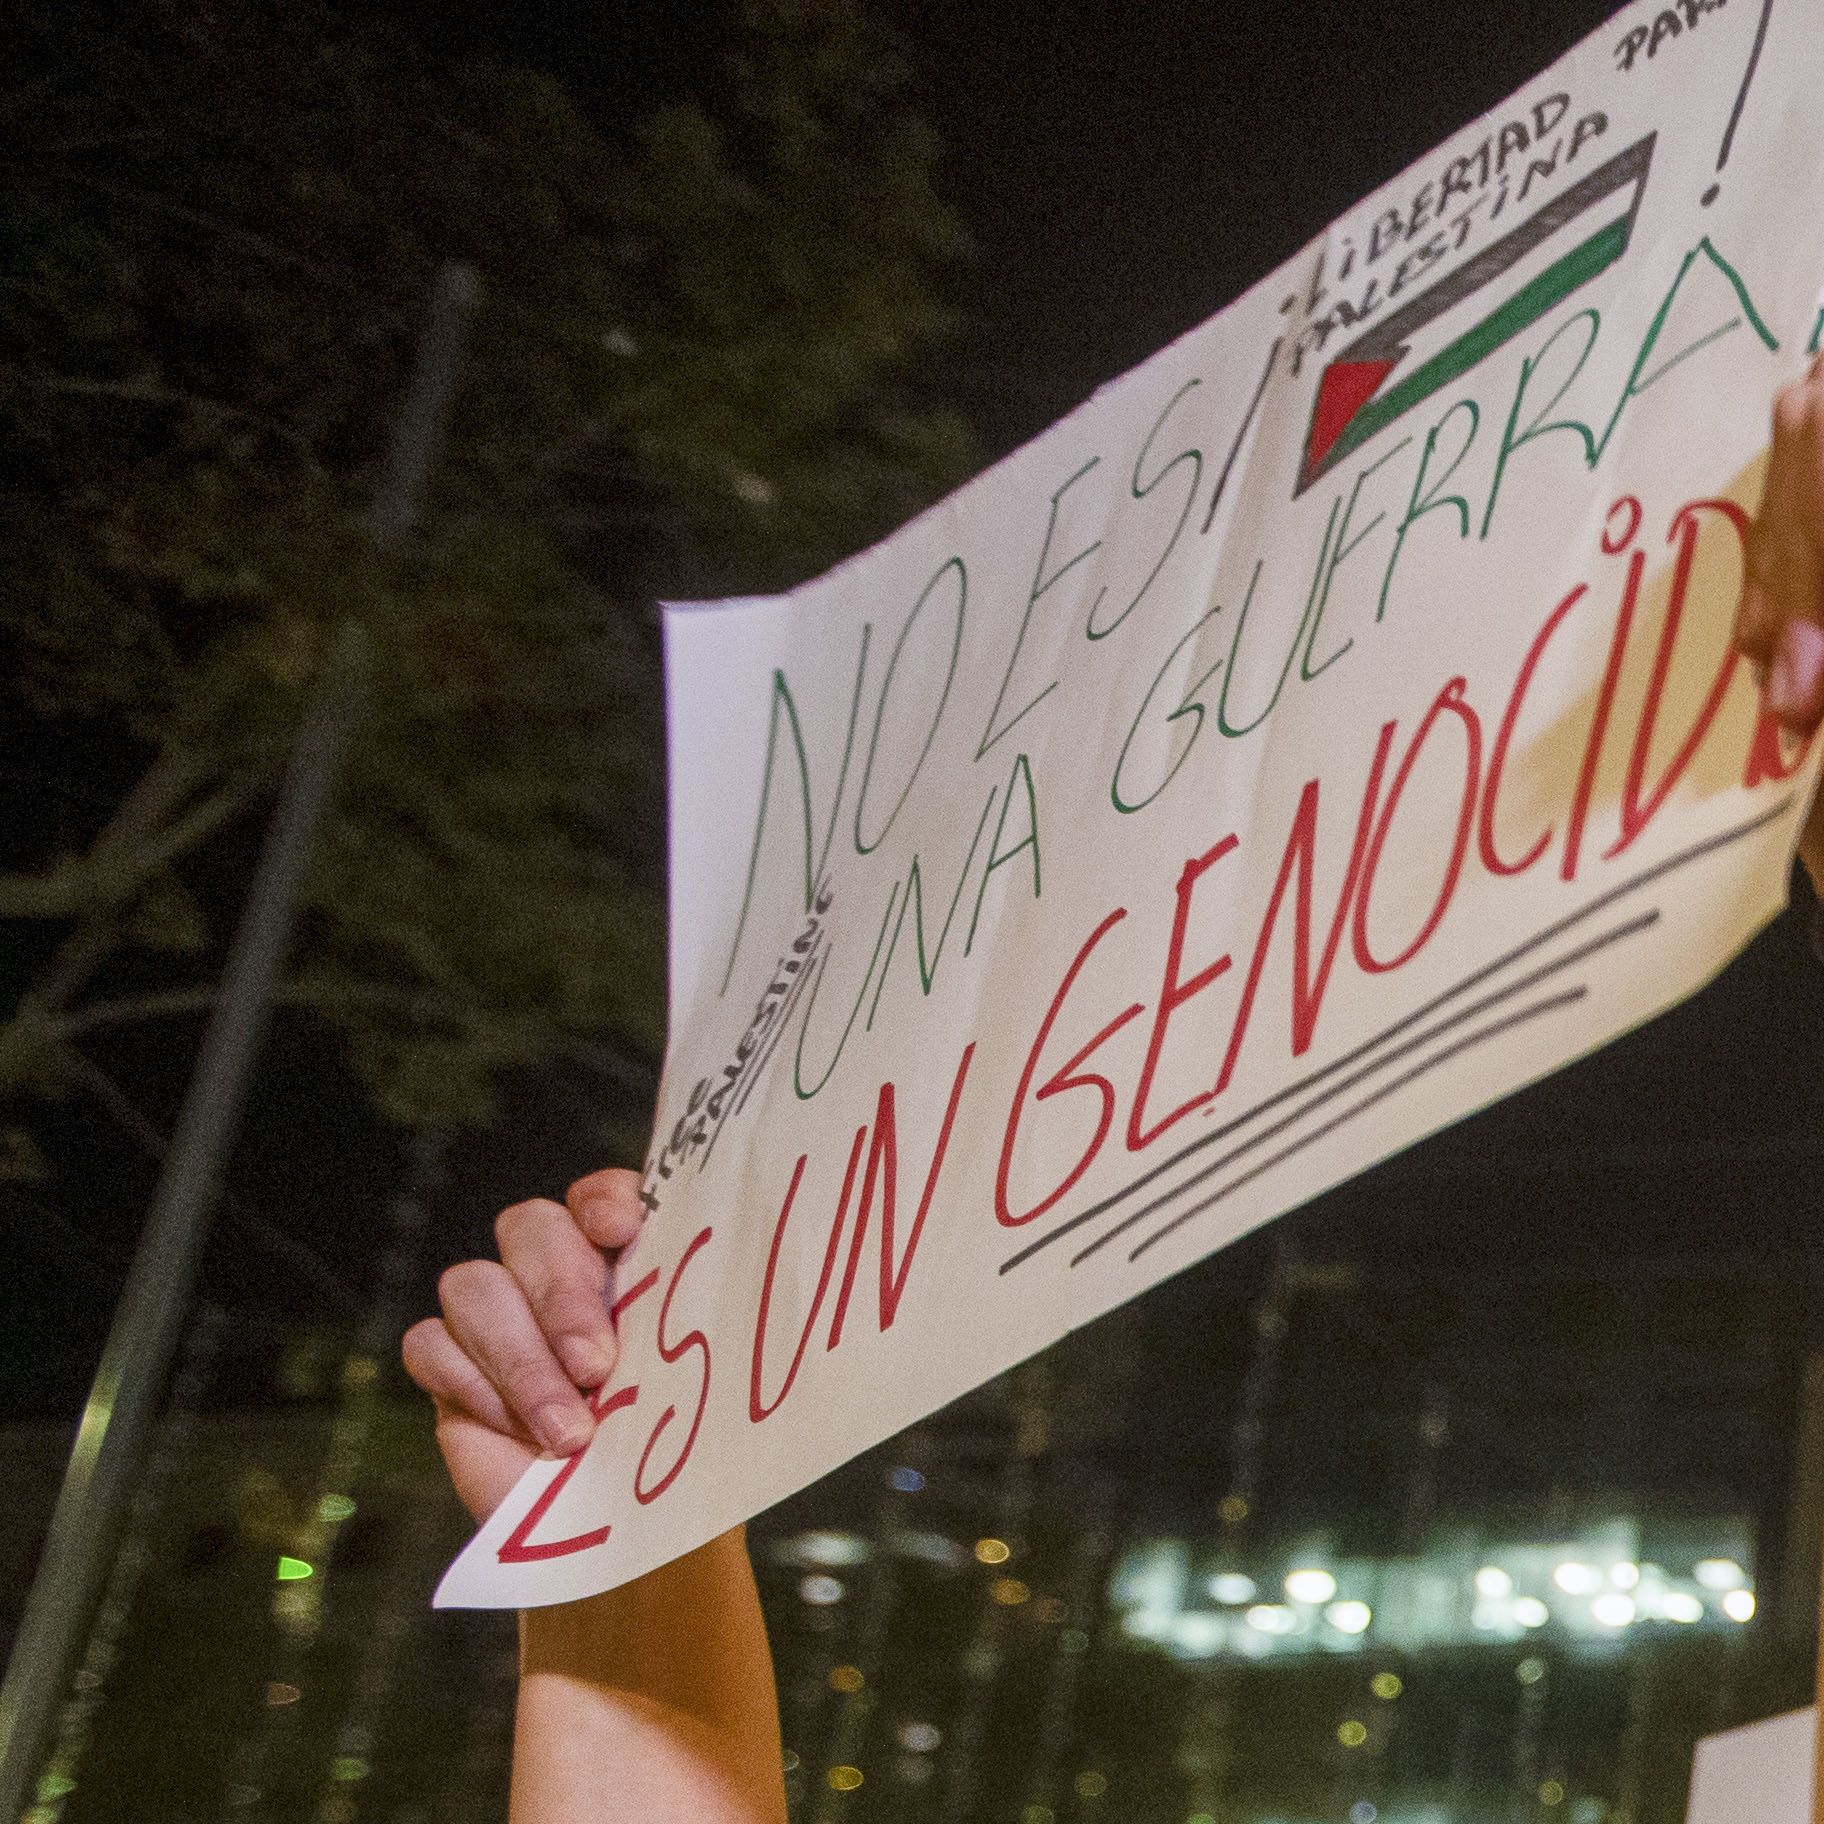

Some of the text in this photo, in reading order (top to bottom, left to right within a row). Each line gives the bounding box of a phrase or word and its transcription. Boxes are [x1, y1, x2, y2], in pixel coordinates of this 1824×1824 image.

[719, 377, 1204, 999] NO ES
[747, 1040, 977, 1424] UN
[994, 494, 1822, 1229] GENOCID
[794, 752, 1043, 1101] UNA
